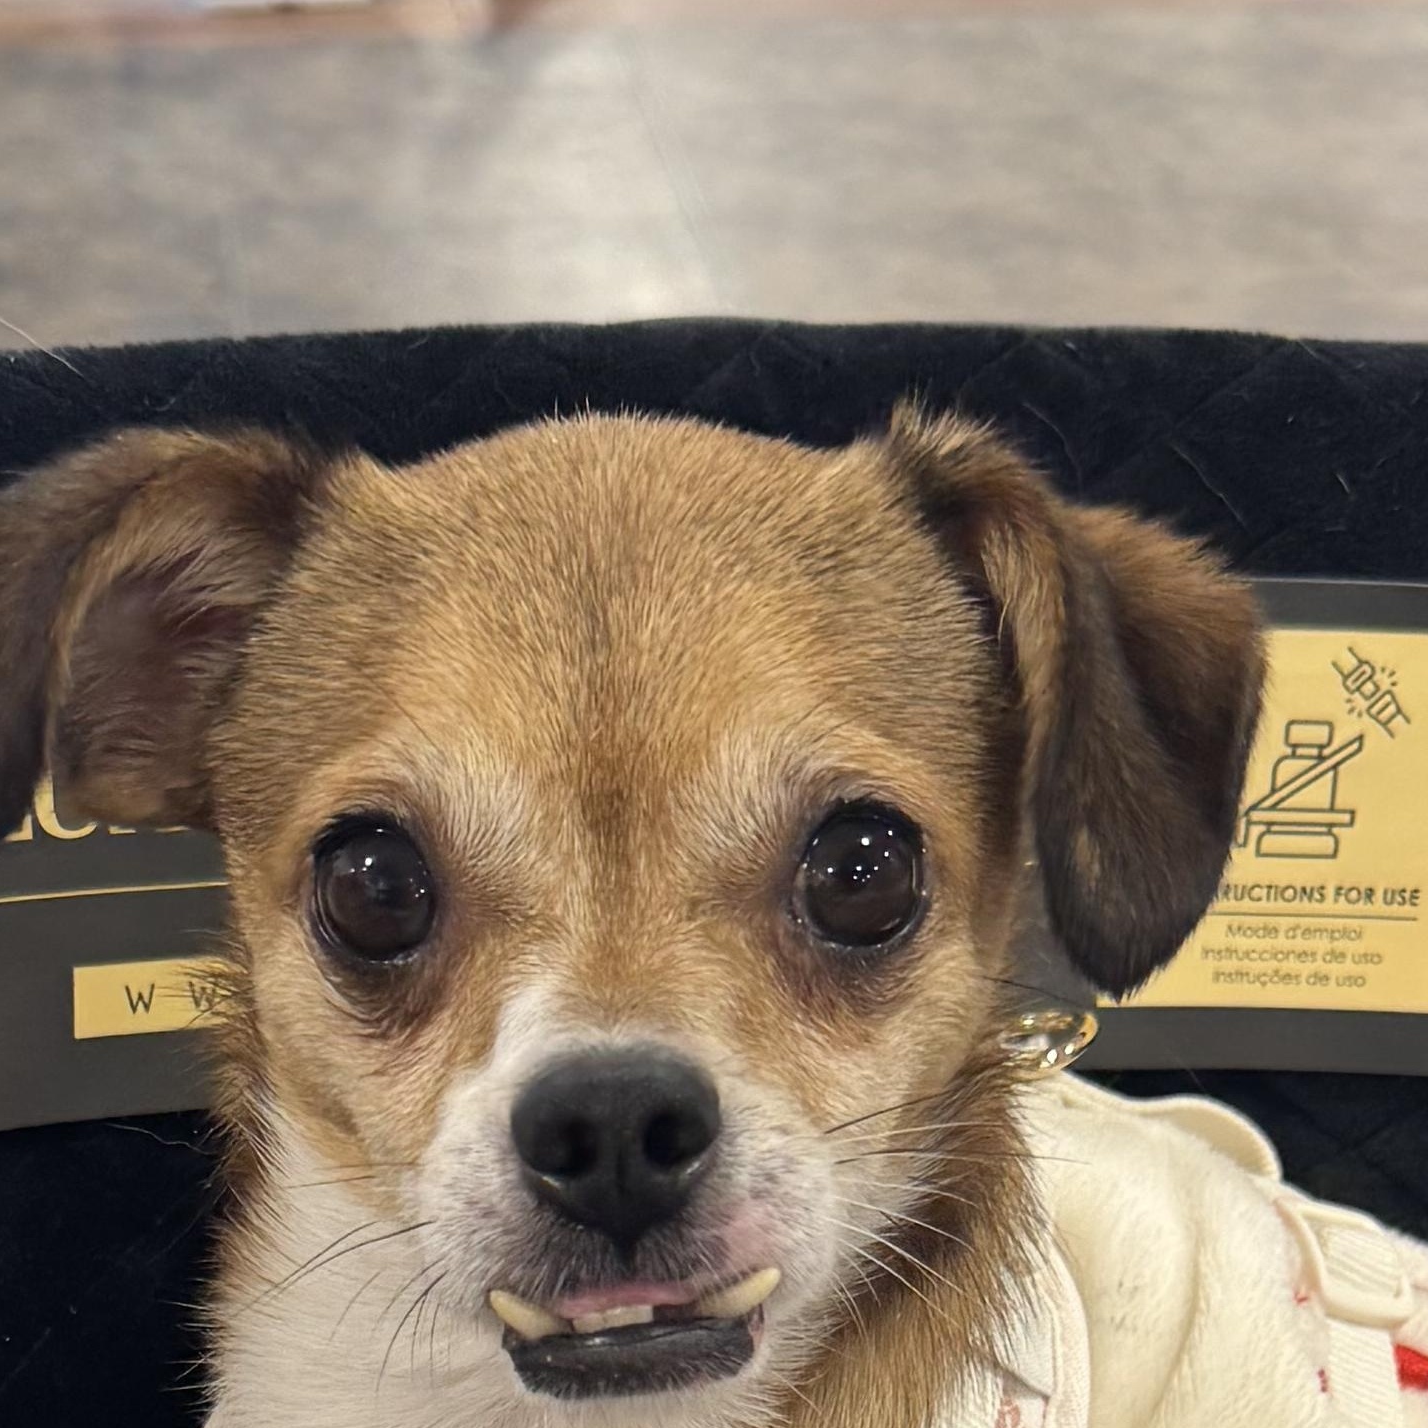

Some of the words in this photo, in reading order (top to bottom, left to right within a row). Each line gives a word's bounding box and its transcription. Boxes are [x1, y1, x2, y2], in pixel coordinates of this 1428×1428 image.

[1217, 883, 1325, 904] RUCTIONS
[1332, 886, 1376, 906] FOR
[1382, 887, 1421, 907] USE
[1225, 924, 1280, 939] Mode
[1201, 946, 1318, 963] Instrucciones
[1322, 948, 1348, 964] de
[1351, 952, 1384, 966] uso
[1305, 970, 1331, 987] de
[1335, 974, 1367, 988] uso
